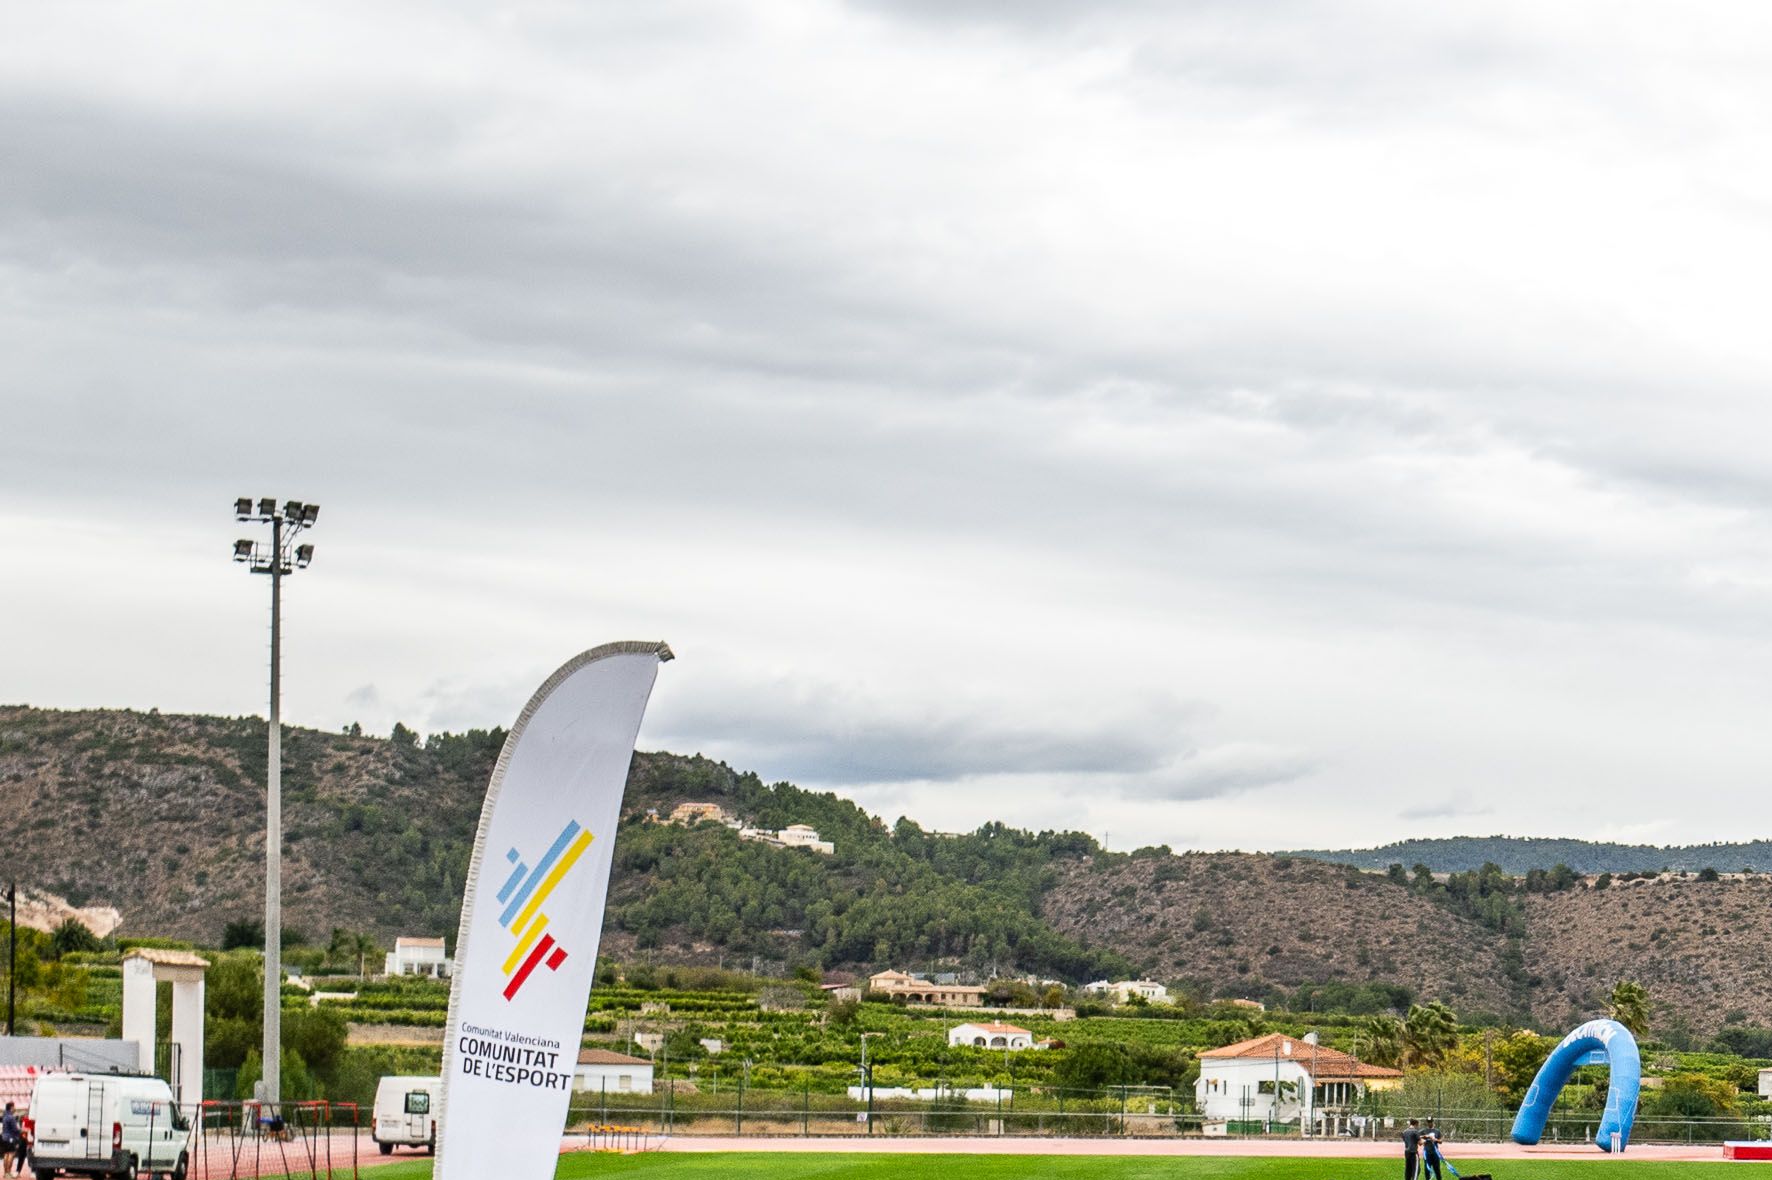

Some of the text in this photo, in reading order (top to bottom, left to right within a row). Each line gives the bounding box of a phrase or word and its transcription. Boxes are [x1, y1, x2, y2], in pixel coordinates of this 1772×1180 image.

[461, 1021, 560, 1049] Comunitat Valenciana
[459, 1036, 559, 1069] COMUNITAT
[463, 1057, 571, 1091] DE L'ESPORT
